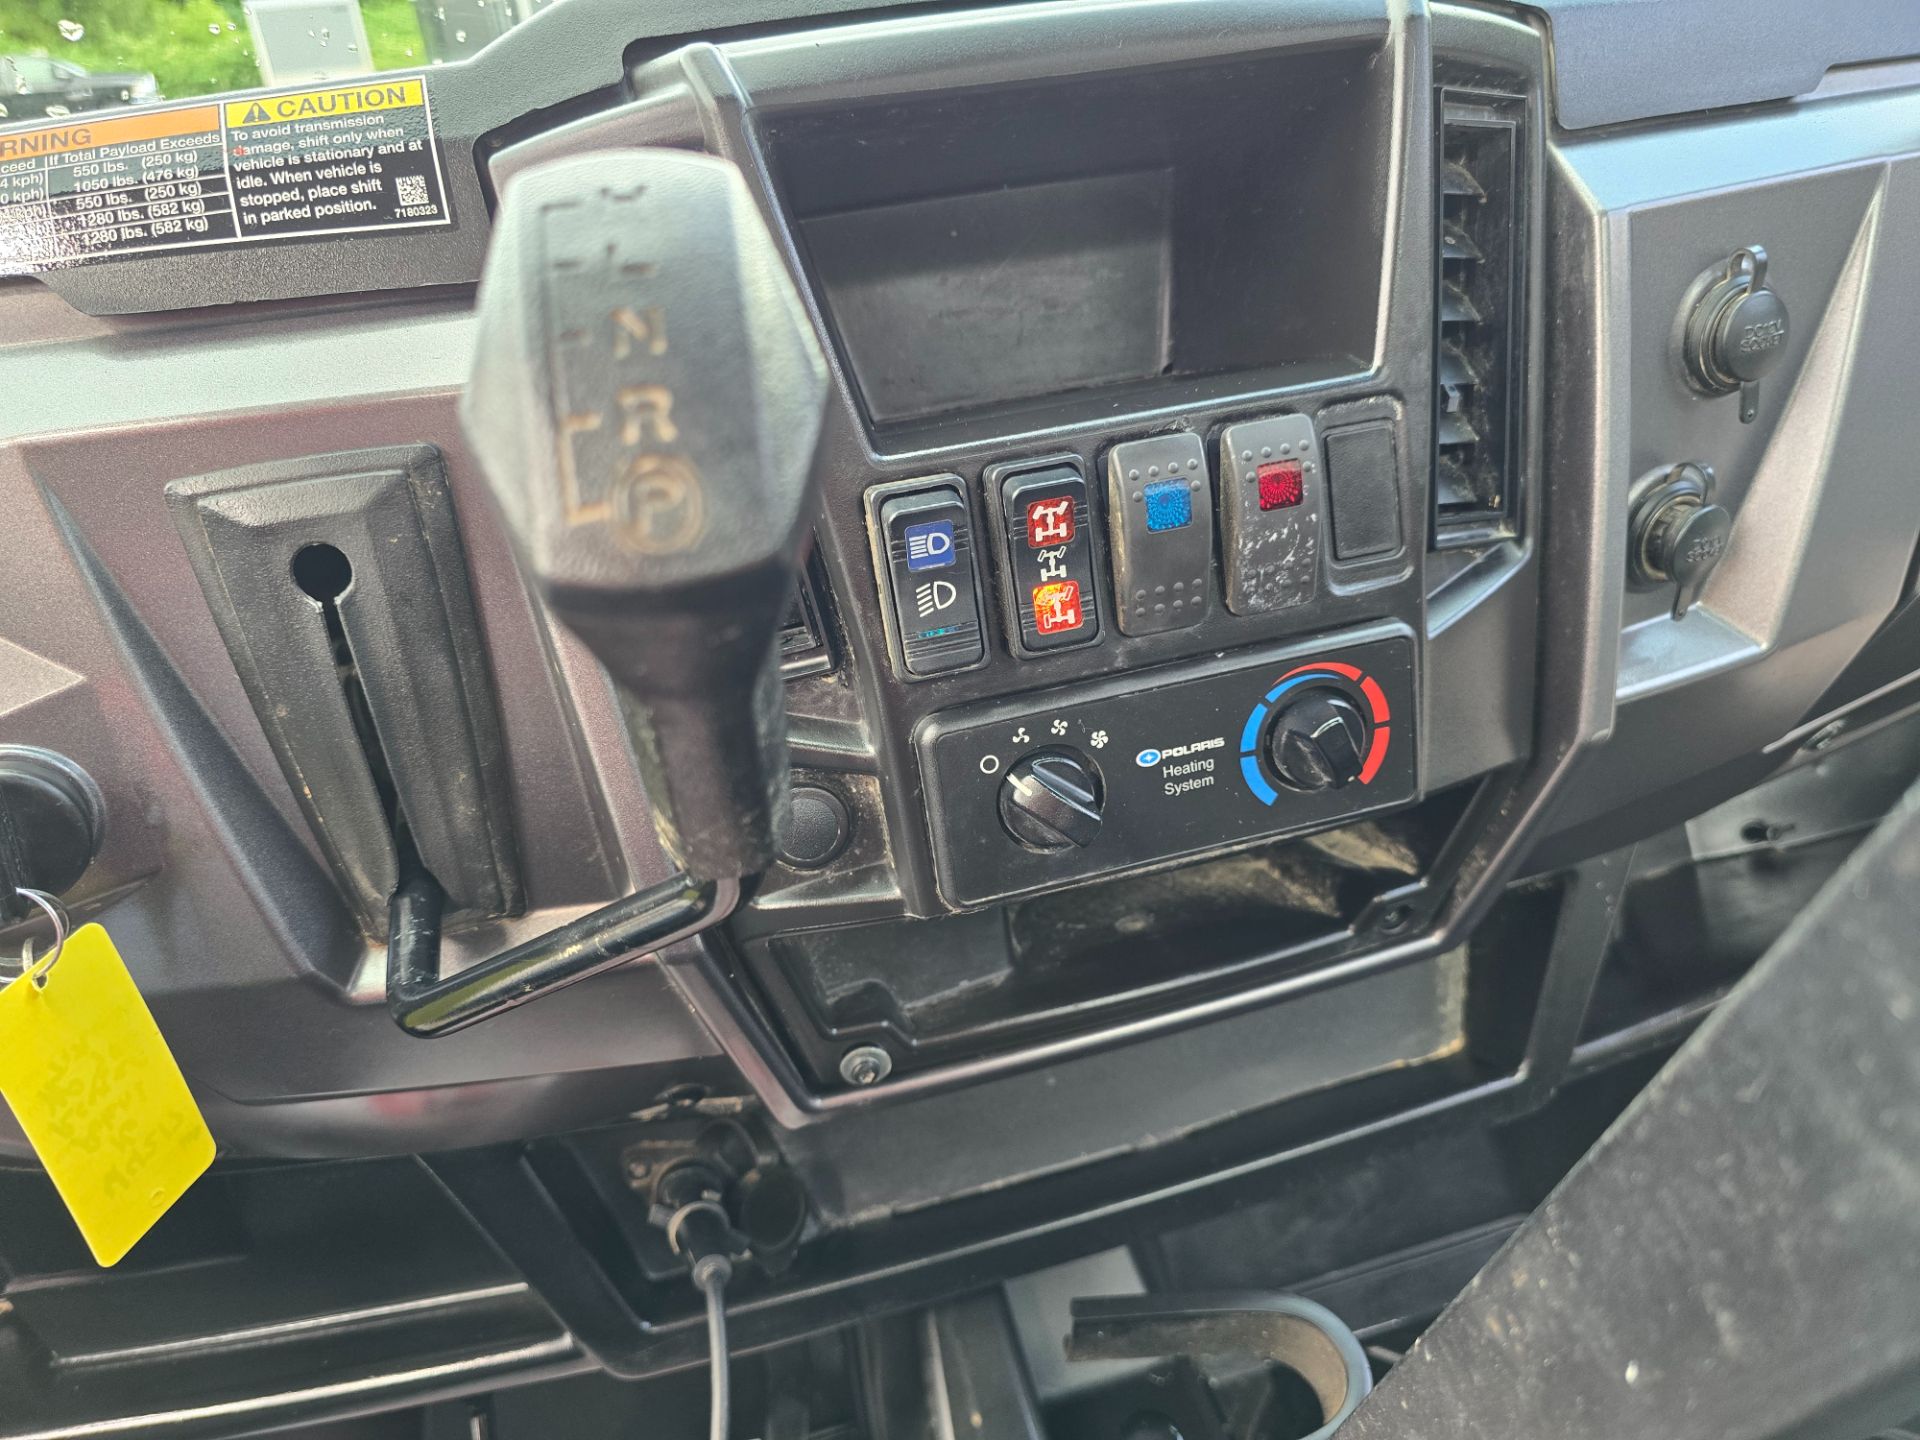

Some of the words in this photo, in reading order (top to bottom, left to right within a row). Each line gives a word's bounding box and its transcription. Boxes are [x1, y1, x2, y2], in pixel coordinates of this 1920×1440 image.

[276, 86, 407, 118] CAUTION
[231, 130, 249, 142] To
[252, 124, 291, 140] avoid
[294, 114, 385, 134] transmission
[233, 139, 294, 157] damage,
[298, 135, 330, 150] shift
[332, 131, 363, 147] only
[366, 127, 404, 140] when
[50, 154, 59, 166] If
[62, 148, 96, 163] Total
[100, 140, 158, 158] Payload
[160, 132, 220, 149] Exceeds
[233, 156, 285, 172] vehicle
[288, 154, 300, 166] is
[304, 147, 375, 164] stationary
[377, 141, 406, 155] and
[408, 139, 423, 151] at
[1, 159, 36, 174] ceed
[73, 164, 100, 177] 550
[103, 161, 128, 174] lbs.
[142, 153, 172, 168] (250
[175, 150, 198, 165] kg)
[236, 176, 268, 190] idle.
[270, 171, 312, 185] When
[315, 164, 367, 181] vehicle
[369, 161, 383, 174] is
[13, 172, 44, 188] kph)
[74, 179, 109, 193] 1050
[112, 175, 138, 188] lbs.
[142, 169, 173, 184] (476
[176, 165, 200, 180] kg)
[13, 188, 45, 204] kph)
[75, 195, 103, 210] 550
[106, 191, 132, 205] lbs.
[145, 185, 176, 201] (250
[179, 181, 202, 197] kg)
[240, 191, 305, 208] stopped,
[307, 185, 348, 201] place
[351, 179, 383, 194] shift
[79, 213, 114, 228] 1280
[118, 207, 144, 222] lbs.
[147, 201, 180, 218] (582
[182, 198, 206, 214] kg)
[243, 212, 258, 225] in
[260, 205, 311, 225] parked
[315, 200, 377, 219] position.
[394, 206, 437, 219] 7180323
[82, 229, 118, 245] 1280
[121, 225, 148, 240] lbs.
[151, 219, 183, 238] (582
[185, 216, 209, 232] kg)
[610, 307, 669, 360] N
[616, 384, 680, 446] R
[1162, 737, 1226, 759] POLARIS
[1163, 758, 1214, 778] Heating
[1164, 775, 1214, 796] System
